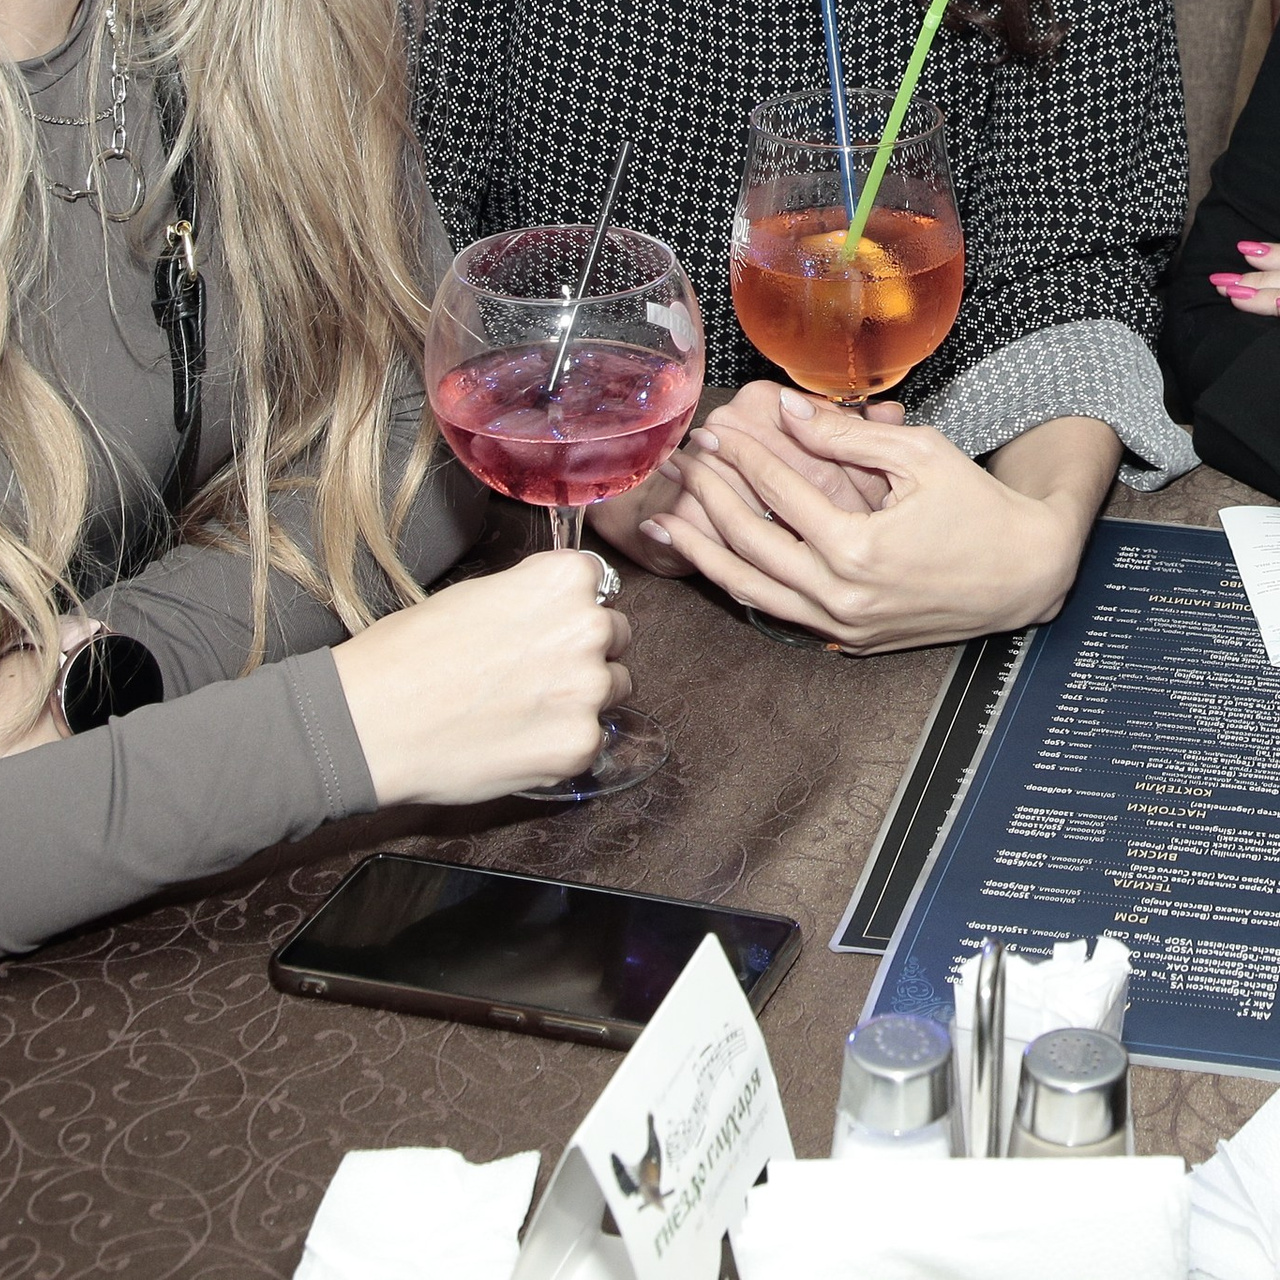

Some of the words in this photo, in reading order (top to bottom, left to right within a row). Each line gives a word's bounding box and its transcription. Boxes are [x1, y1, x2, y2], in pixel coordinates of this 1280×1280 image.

[1148, 594, 1211, 607] НАПИТКИ
[1195, 716, 1225, 728] Spritz)
[1225, 720, 1258, 732] (Aperol
[1216, 731, 1250, 743] Colada)
[1250, 736, 1274, 745] (Pina
[1182, 752, 1219, 763] Sunrise)
[1254, 747, 1271, 758] Tai)
[1110, 757, 1144, 768] Linden)
[1145, 761, 1163, 769] and
[1219, 754, 1256, 767] (Tequila
[1164, 764, 1185, 772] Pear
[1186, 764, 1236, 777] (Botanicals
[1144, 773, 1167, 783] Tonic)
[1167, 776, 1188, 785] Fiero
[1188, 779, 1219, 788] (Martini
[1134, 781, 1212, 797] КОКТЕЙЛИ
[1219, 782, 1247, 791] тоник
[1248, 783, 1279, 795] Фиеро
[1126, 802, 1206, 818] НАСТОЙКИ
[1189, 800, 1255, 815] (Jagermeister)
[1145, 818, 1174, 827] years)
[1188, 824, 1236, 835] (Singleton
[1126, 839, 1165, 850] (Proper)
[1216, 833, 1264, 846] (Hatozaki)
[1166, 842, 1203, 855] Пропер
[1211, 841, 1236, 851] (Jack
[1126, 847, 1177, 861] ВИСКИ
[1209, 848, 1261, 861] (Bushmills)
[1129, 862, 1155, 873] Gold)
[1156, 866, 1190, 877] Cuervo
[1103, 868, 1134, 879] Silver)
[1135, 872, 1169, 883] Cuervo
[1190, 870, 1215, 880] (Jose
[1113, 877, 1171, 893] ТЕКИЛА
[1170, 876, 1195, 885] (Jose
[1196, 878, 1236, 889] сильвер
[1240, 875, 1276, 886] Куэрво
[1238, 883, 1273, 894] Куэрво
[1140, 896, 1172, 907] Anejo)
[1173, 901, 1213, 912] (Barcelo
[1132, 904, 1168, 916] Blanco)
[1170, 909, 1210, 920] (Barcelo
[1214, 905, 1251, 916] Аньехо
[1113, 911, 1149, 924] РОМ
[1211, 913, 1248, 925] Бланко
[1101, 928, 1129, 939] Cask)
[1133, 932, 1160, 943] Triple
[1163, 936, 1193, 946] VSOP
[1164, 944, 1193, 955] VSOP
[1142, 951, 1190, 964] American
[1150, 970, 1166, 980] Tre
[1169, 972, 1184, 982] VS
[1169, 980, 1184, 990] VS
[1252, 999, 1273, 1010] Айк
[1249, 1009, 1271, 1020] Айк
